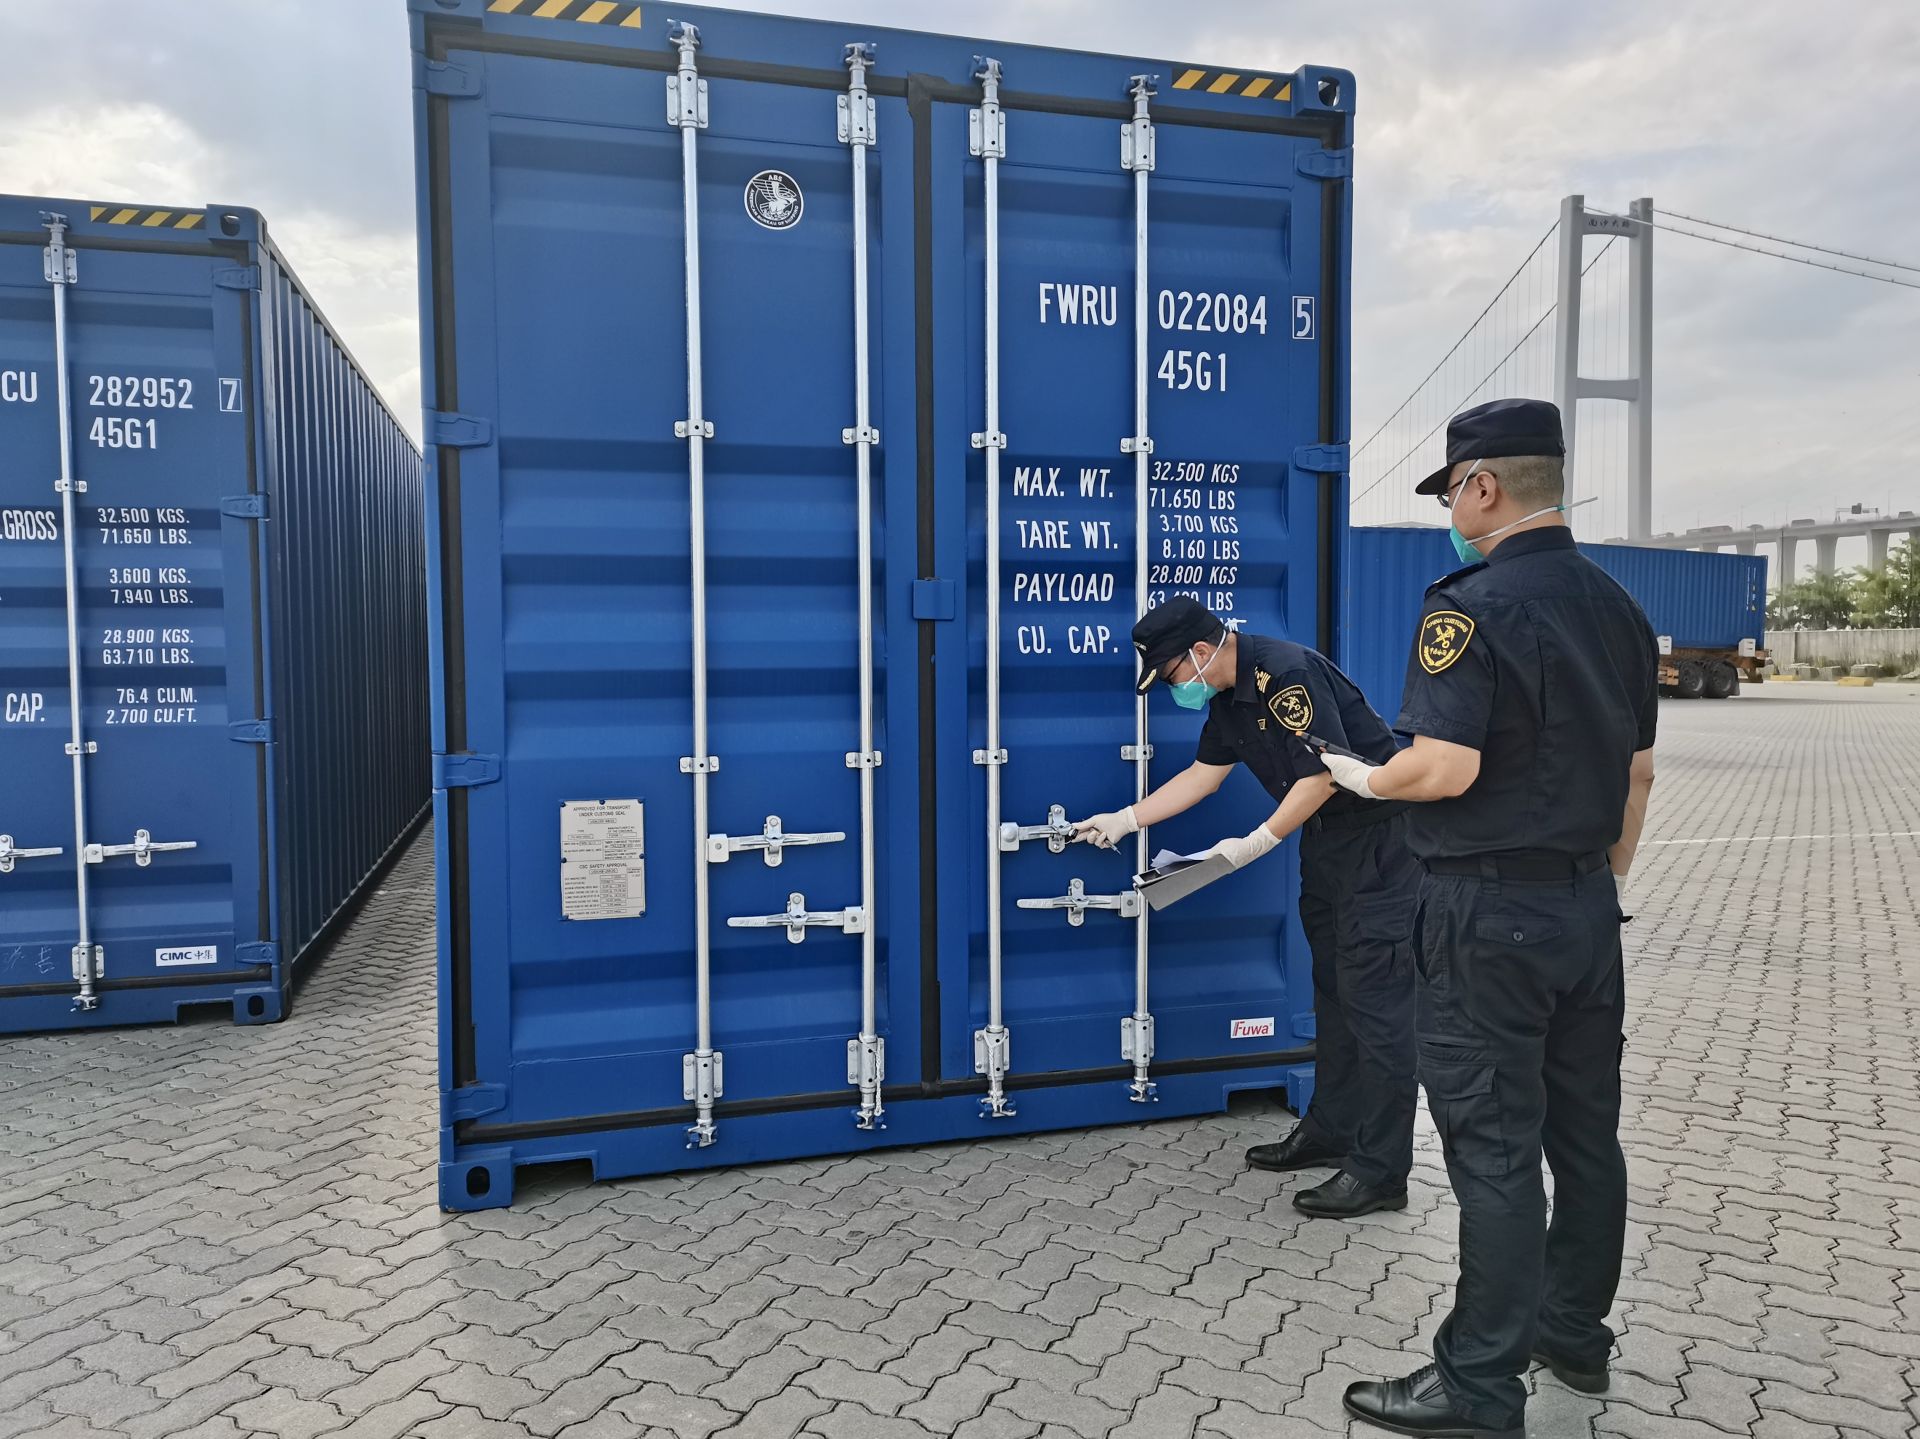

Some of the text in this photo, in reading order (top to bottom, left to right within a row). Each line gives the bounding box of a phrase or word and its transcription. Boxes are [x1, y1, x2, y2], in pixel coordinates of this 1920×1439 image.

[768, 174, 783, 182] ABS
[1039, 282, 1311, 337] FWRU 022084 5
[1157, 349, 1227, 392] 45G1
[1, 371, 239, 410] CU 282952 7
[89, 416, 157, 449] 45G1
[1013, 466, 1114, 498] MAX. WT.
[1210, 463, 1240, 484] KGS
[1208, 489, 1235, 511] LBS
[156, 508, 190, 524] KGS.
[1209, 515, 1239, 534] KGS
[159, 529, 192, 545] LBS.
[1015, 520, 1118, 549] TARE WT.
[1213, 540, 1240, 561] LBS
[158, 567, 191, 584] KGS.
[1208, 566, 1238, 585] KGS
[159, 588, 193, 604] LBS.
[1014, 573, 1114, 602] PAYLOAD
[1207, 591, 1234, 611] LBS
[1427, 617, 1469, 633] CHINA CUSTOMS
[162, 628, 194, 644] KGS.
[1017, 625, 1118, 654] CU. CAP.
[161, 648, 195, 664] LBS.
[116, 687, 198, 704] 76.4 CU.M.
[5, 692, 45, 723] CAP.
[153, 707, 197, 723] CU.FT.
[160, 951, 192, 961] CIMC
[1233, 1021, 1269, 1036] Fuwa
